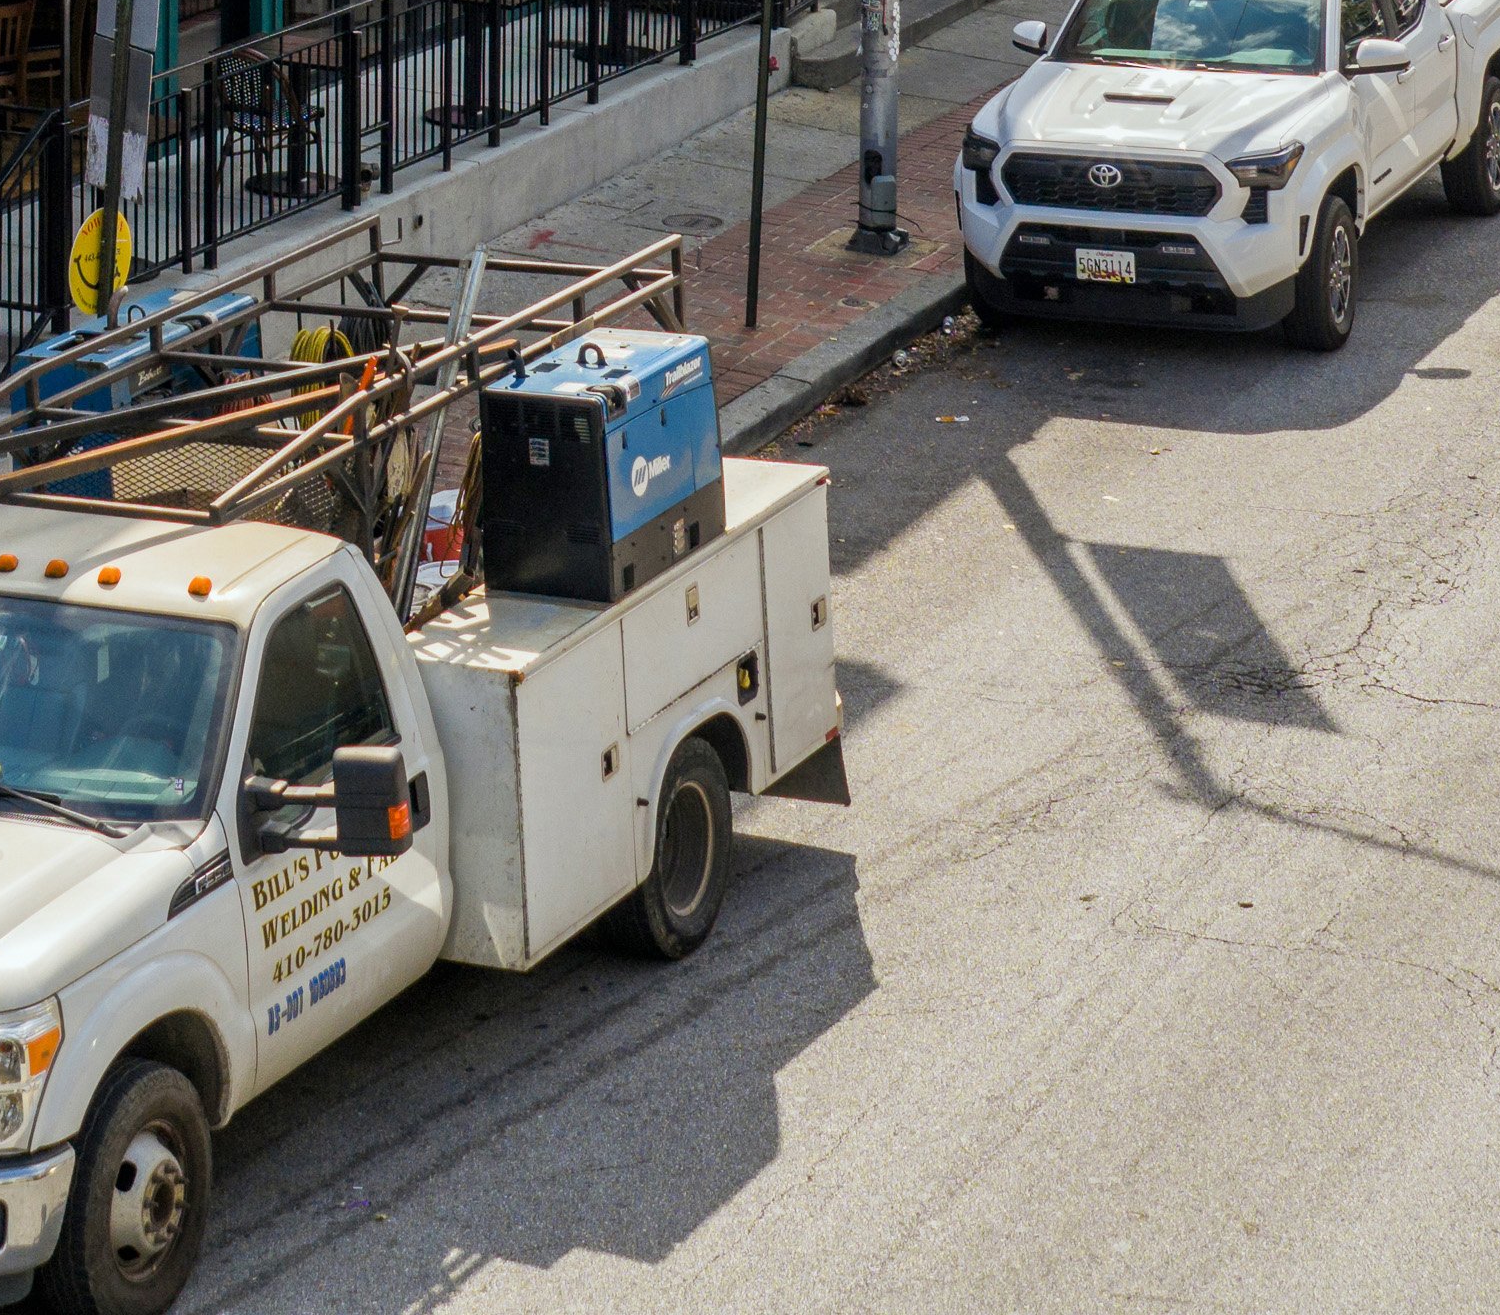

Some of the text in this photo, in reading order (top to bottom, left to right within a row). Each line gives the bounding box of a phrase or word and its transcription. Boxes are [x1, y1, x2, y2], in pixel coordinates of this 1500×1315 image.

[1078, 257, 1134, 276] 5GN3114
[648, 454, 671, 480] Miller
[250, 855, 310, 913] BILL'S
[261, 877, 344, 950] WELDING
[348, 866, 362, 891] &
[272, 884, 392, 984] 410-780-3015
[267, 985, 304, 1036] US-DOT
